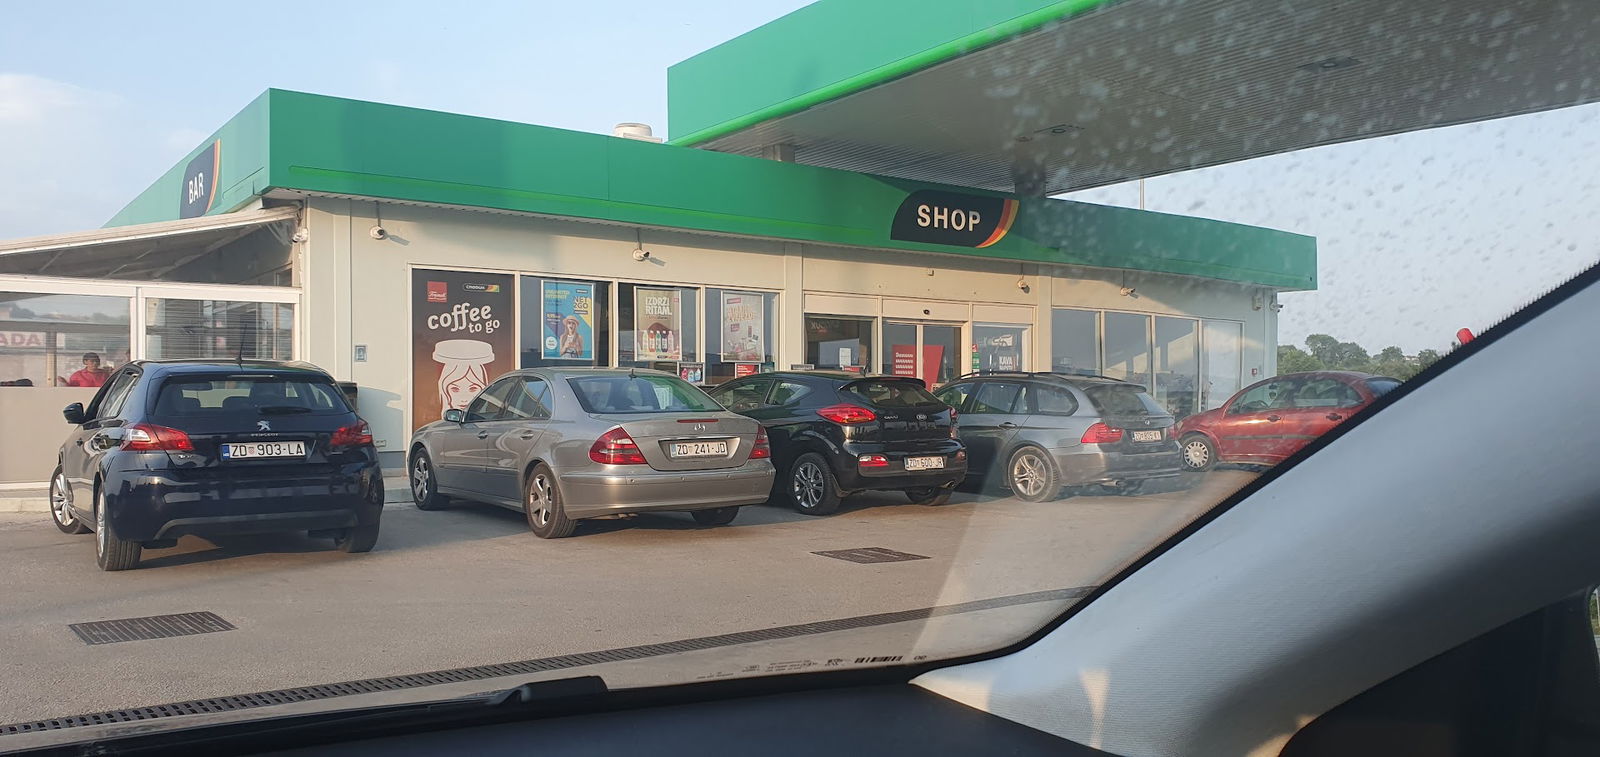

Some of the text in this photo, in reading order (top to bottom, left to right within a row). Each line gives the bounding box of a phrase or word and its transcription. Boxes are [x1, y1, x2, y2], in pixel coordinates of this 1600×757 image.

[188, 172, 204, 205] BAR
[917, 204, 981, 232] SHOP
[427, 302, 492, 332] coffee
[468, 319, 500, 334] to go
[232, 443, 304, 457] ZD 903-LA
